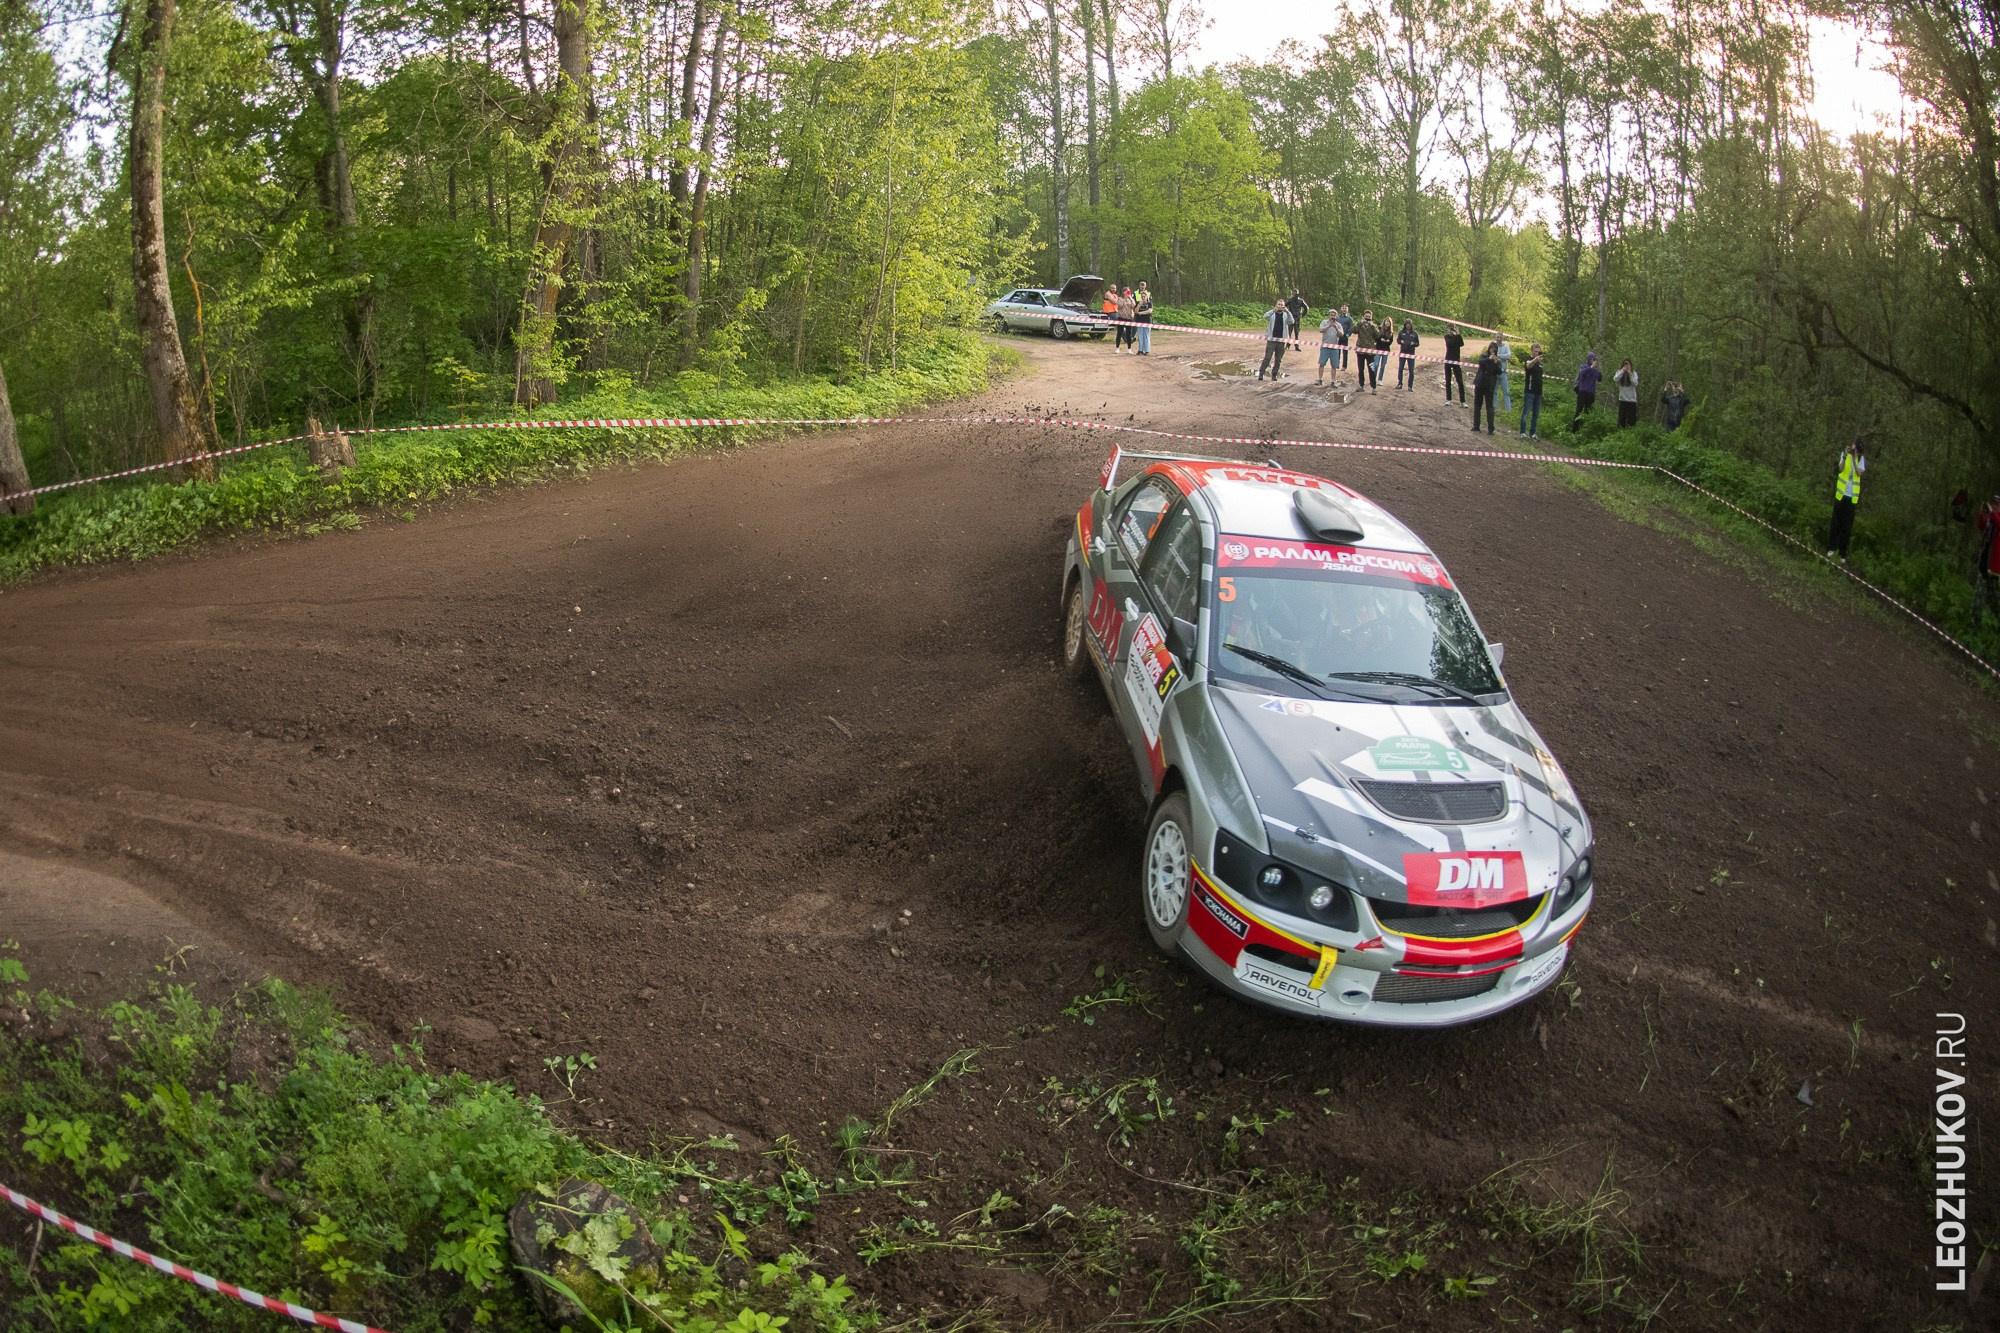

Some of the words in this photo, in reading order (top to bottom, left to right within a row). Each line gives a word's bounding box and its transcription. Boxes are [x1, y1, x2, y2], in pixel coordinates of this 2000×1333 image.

[1253, 547, 1332, 562] РАЛЛИ
[1337, 552, 1417, 574] РОССИИ
[1218, 577, 1236, 602] 5
[1159, 668, 1177, 696] 5
[1294, 703, 1305, 713] E
[1395, 742, 1431, 750] РАЛЛИ
[1446, 751, 1463, 769] 5
[1435, 857, 1504, 891] DM
[1204, 895, 1242, 933] YOKOHAMA
[1250, 970, 1315, 1001] RAVENOL
